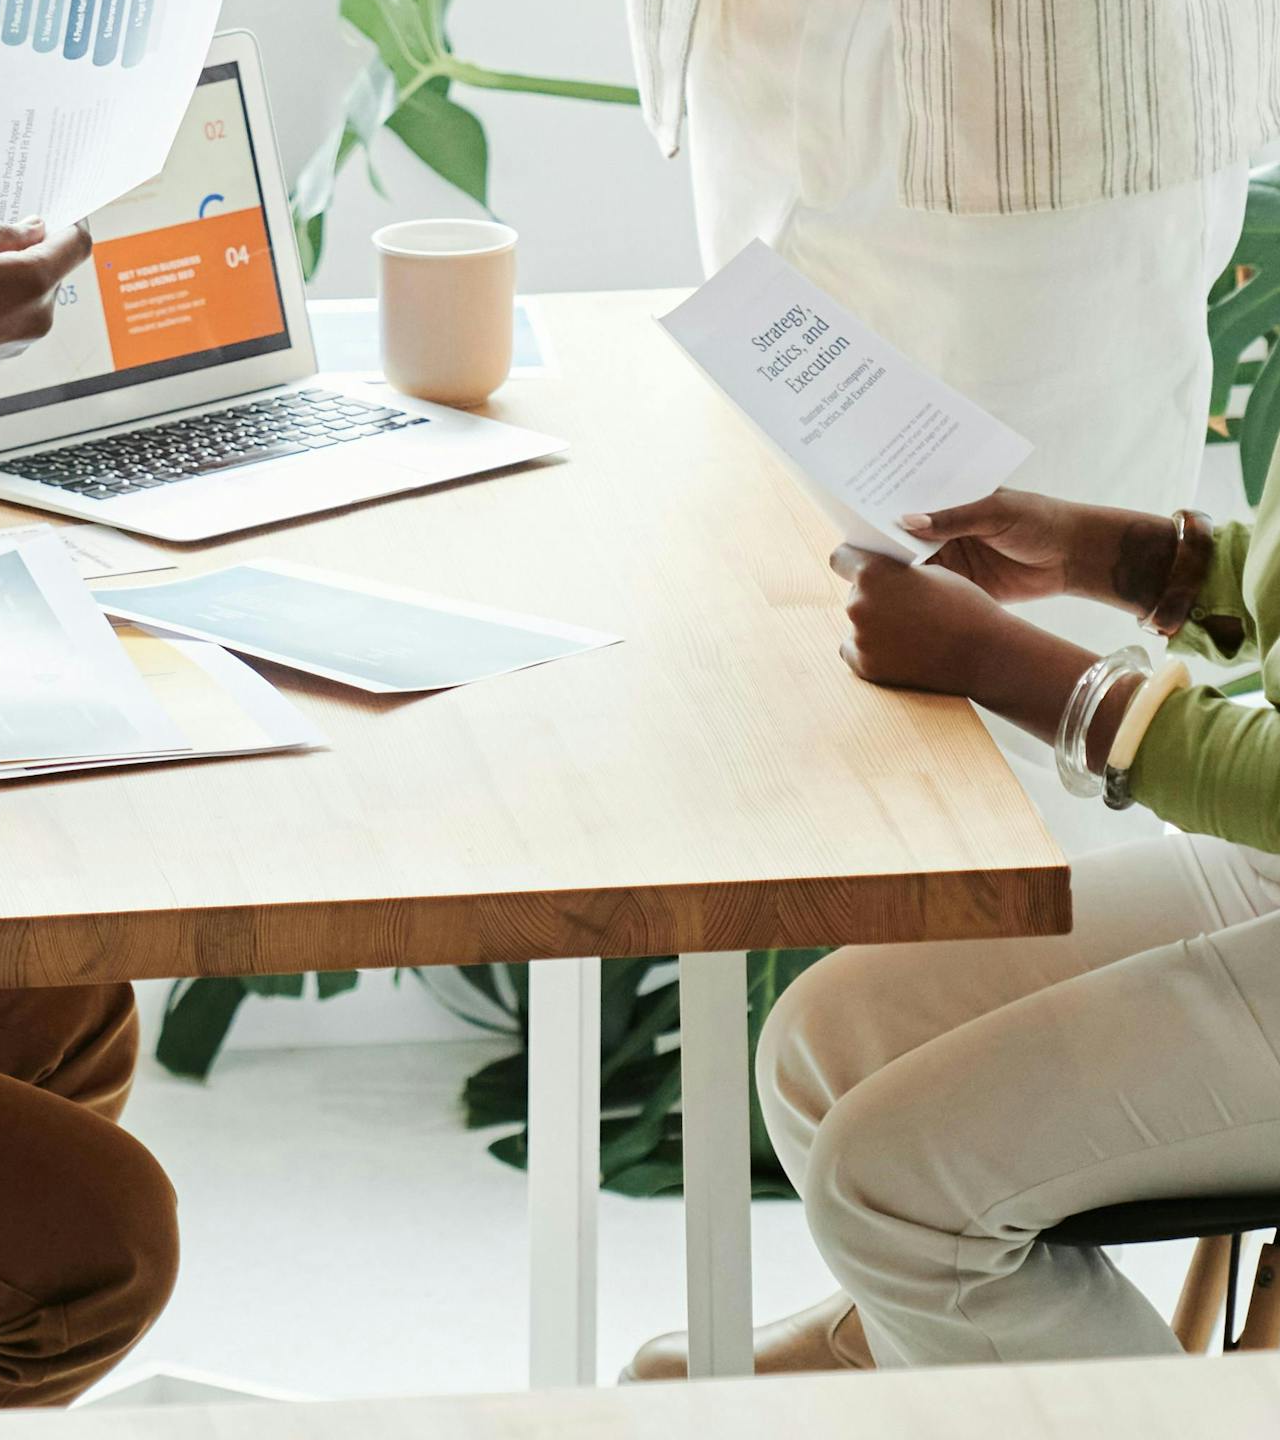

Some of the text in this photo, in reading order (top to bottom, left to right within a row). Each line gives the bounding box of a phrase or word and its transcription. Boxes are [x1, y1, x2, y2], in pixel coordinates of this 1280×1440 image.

[204, 120, 226, 141] 02
[225, 245, 250, 268] 04
[751, 304, 811, 352] Strategy,
[756, 315, 830, 382] Tactics, and
[785, 336, 851, 394] Execution
[821, 389, 839, 406] Your
[836, 358, 874, 392] Company's
[840, 396, 855, 412] and
[850, 367, 886, 400] Execution
